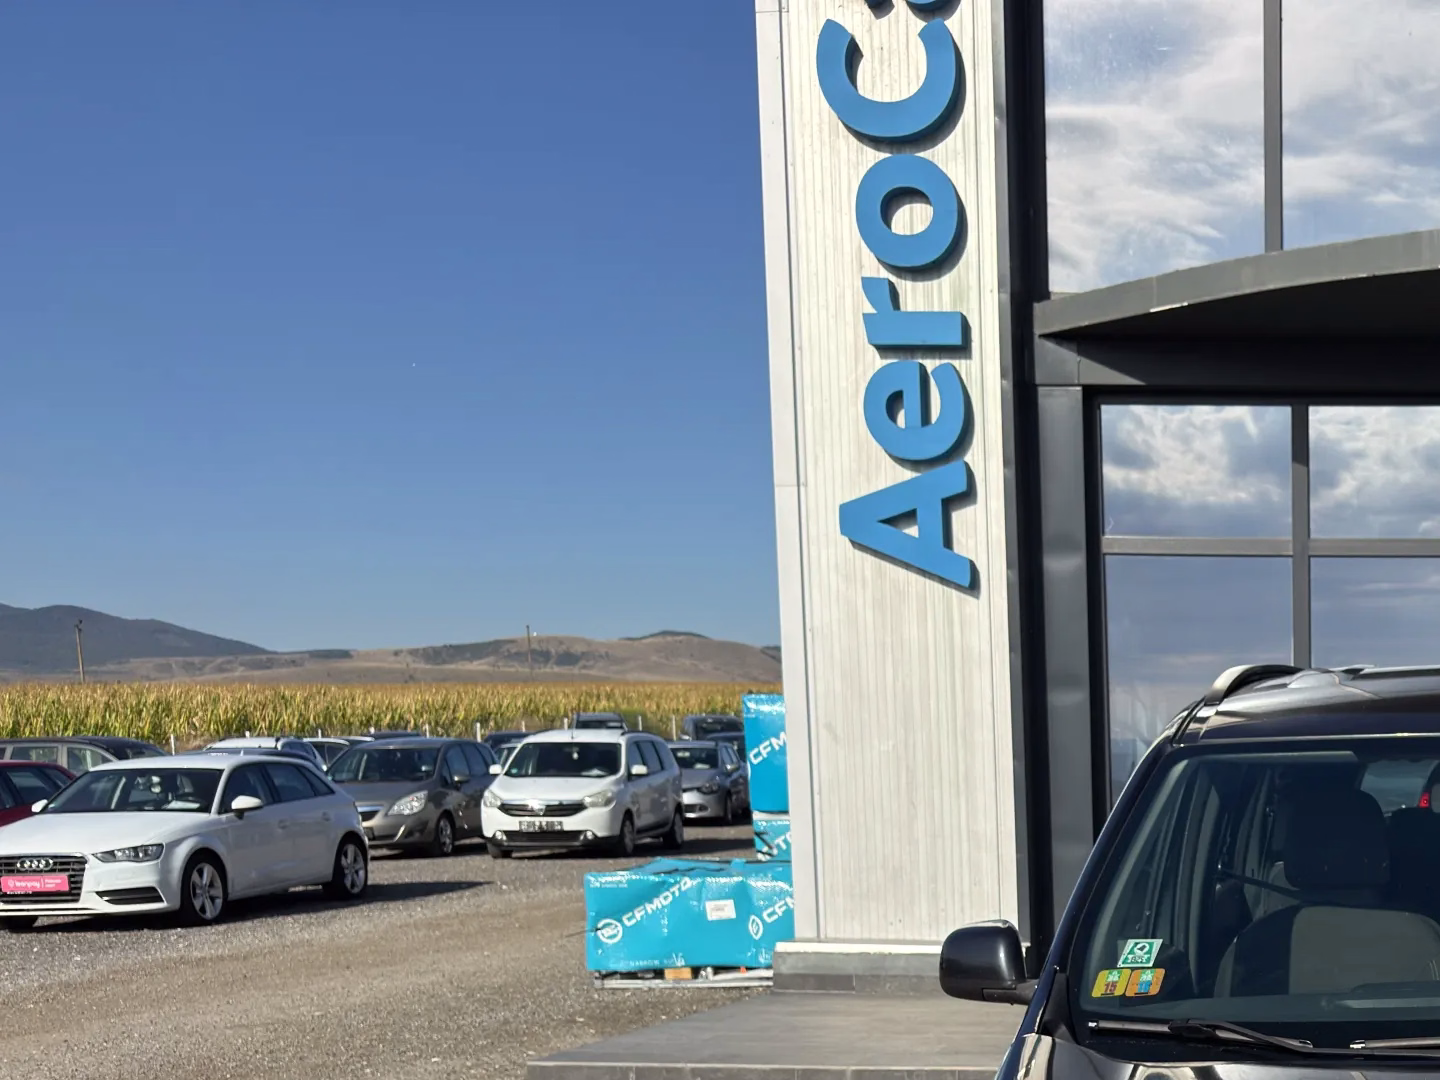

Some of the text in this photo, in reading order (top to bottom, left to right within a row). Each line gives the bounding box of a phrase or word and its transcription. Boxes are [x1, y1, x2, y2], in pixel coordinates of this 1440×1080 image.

[815, 0, 975, 590] AeroC
[621, 876, 693, 928] CFMOTO
[1103, 981, 1118, 993] 15
